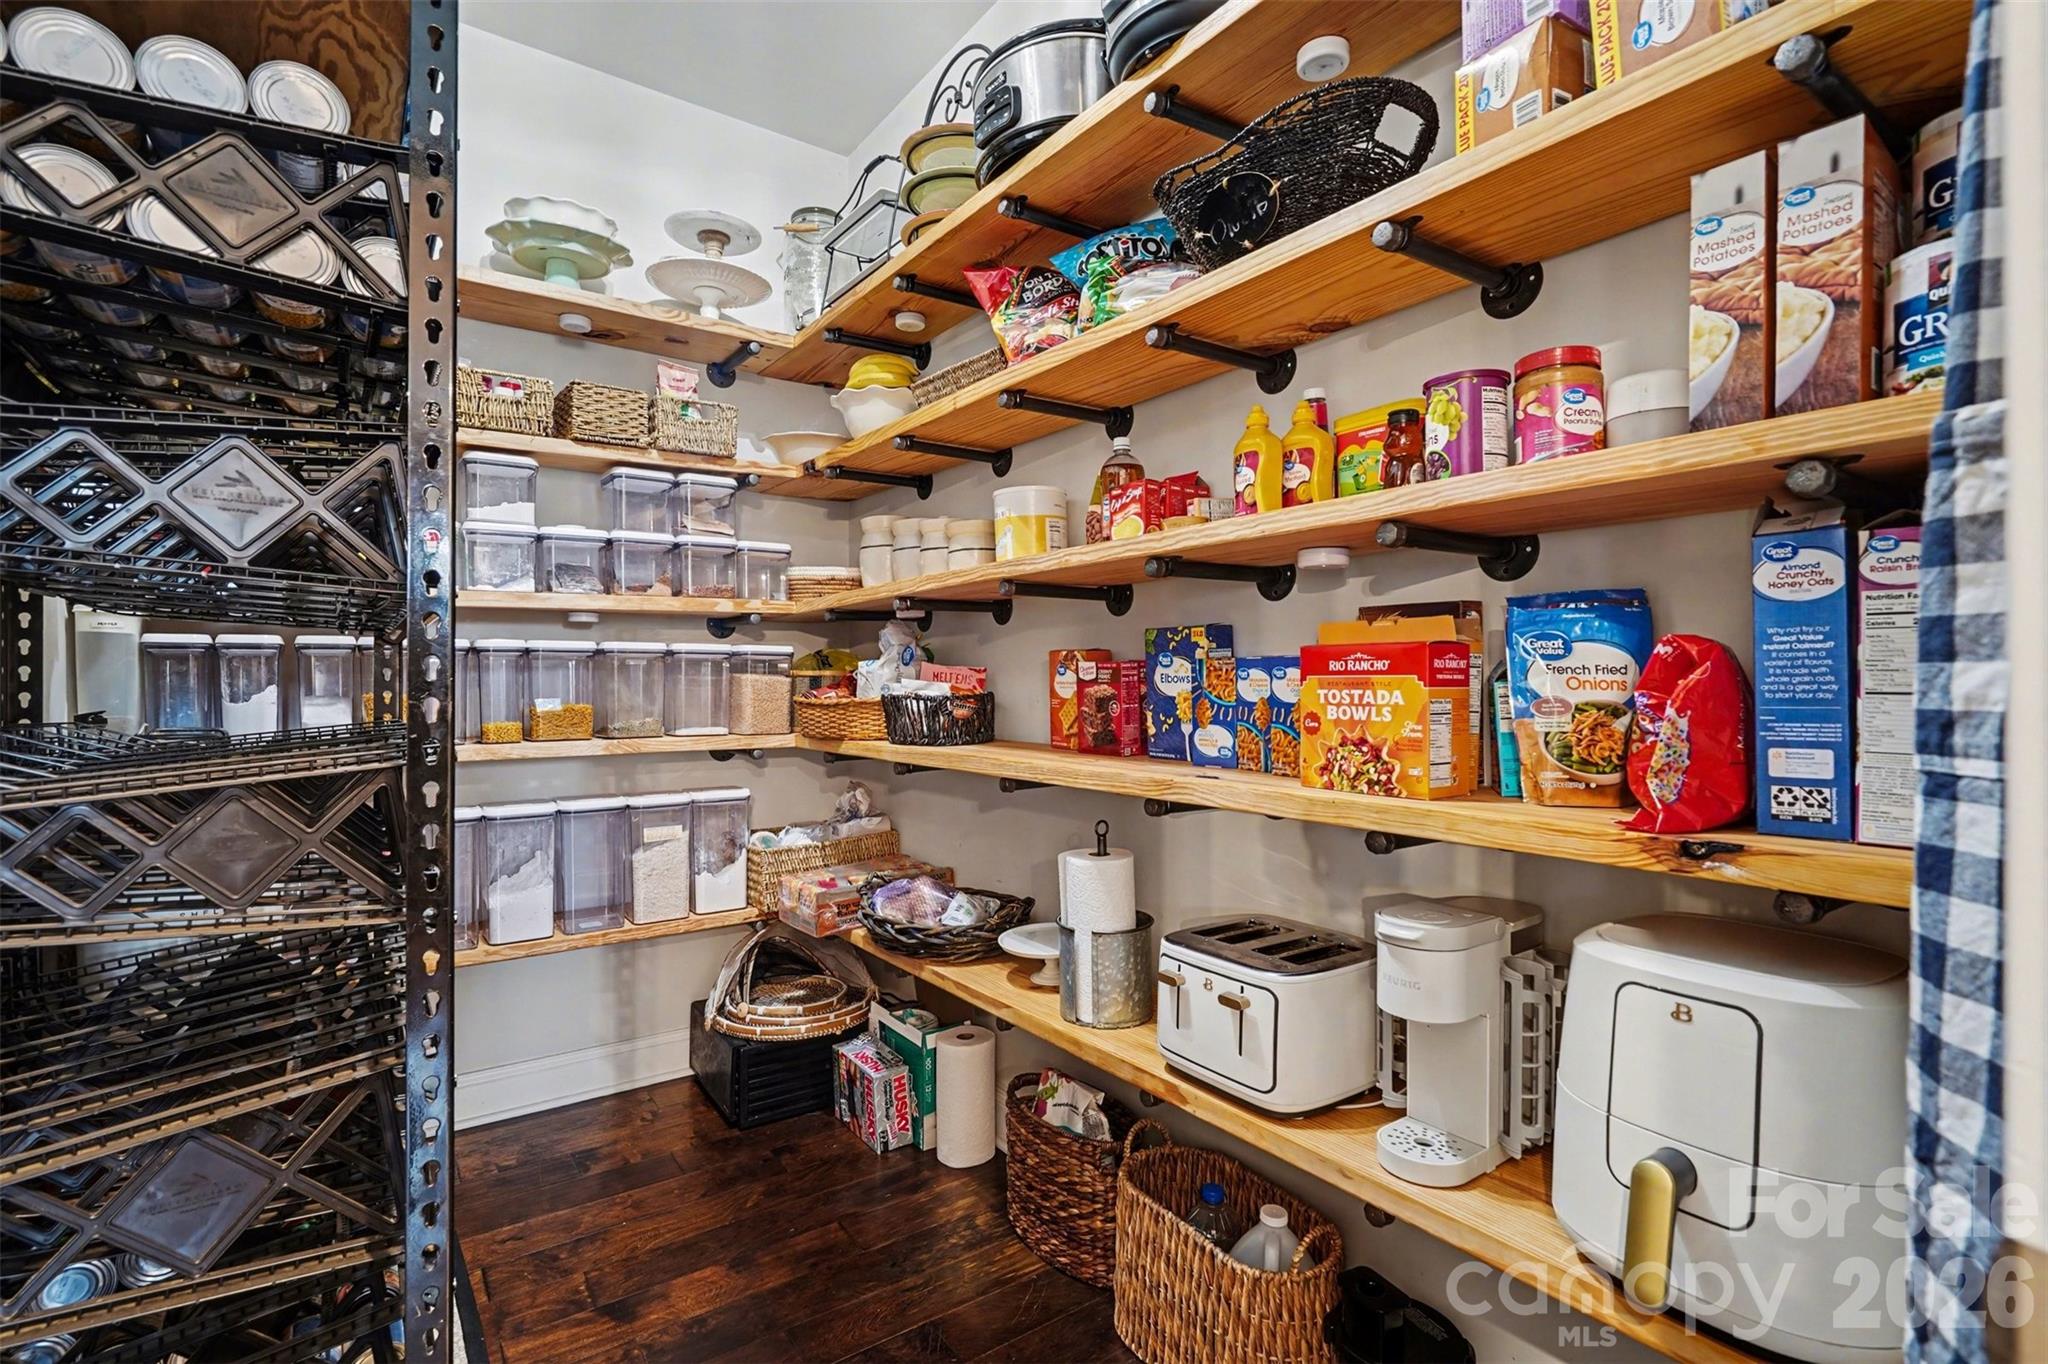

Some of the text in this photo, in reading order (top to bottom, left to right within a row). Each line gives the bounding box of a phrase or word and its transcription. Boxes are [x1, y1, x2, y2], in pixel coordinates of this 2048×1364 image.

[1597, 14, 1614, 57] PACK
[1458, 90, 1470, 129] PACK
[1786, 202, 1854, 229] Mashed
[1782, 213, 1854, 243] Potatoes
[1697, 229, 1756, 256] Mashed
[1693, 242, 1756, 269] Potatoes
[1024, 276, 1043, 289] ON
[1022, 276, 1066, 304] BORD
[1765, 546, 1793, 556] Great
[1780, 561, 1821, 571] Almond
[1869, 564, 1903, 573] Raisin
[1776, 569, 1825, 580] Crunchy
[1767, 577, 1835, 590] Honey Oats
[1865, 593, 1905, 601] Nutrition
[1766, 626, 1785, 635] Why
[1802, 625, 1815, 633] try
[1527, 637, 1565, 649] Great
[1772, 634, 1797, 642] Great
[1536, 647, 1566, 656] Value
[1762, 641, 1836, 651] Instant Oatmeal?
[1329, 660, 1390, 672] RIO RANCHO
[1545, 663, 1628, 676] French Fried
[1811, 666, 1830, 674] with
[1160, 672, 1191, 684] Elbows
[1565, 675, 1629, 692] Onions
[1791, 676, 1814, 684] grain
[1794, 684, 1819, 692] great
[1316, 688, 1406, 706] TOSTADA
[1794, 692, 1814, 700] your
[1326, 704, 1393, 723] BOWLS
[851, 1050, 886, 1074] HUSKY
[863, 1075, 878, 1143] HUSKY
[893, 1073, 911, 1134] HUSKY
